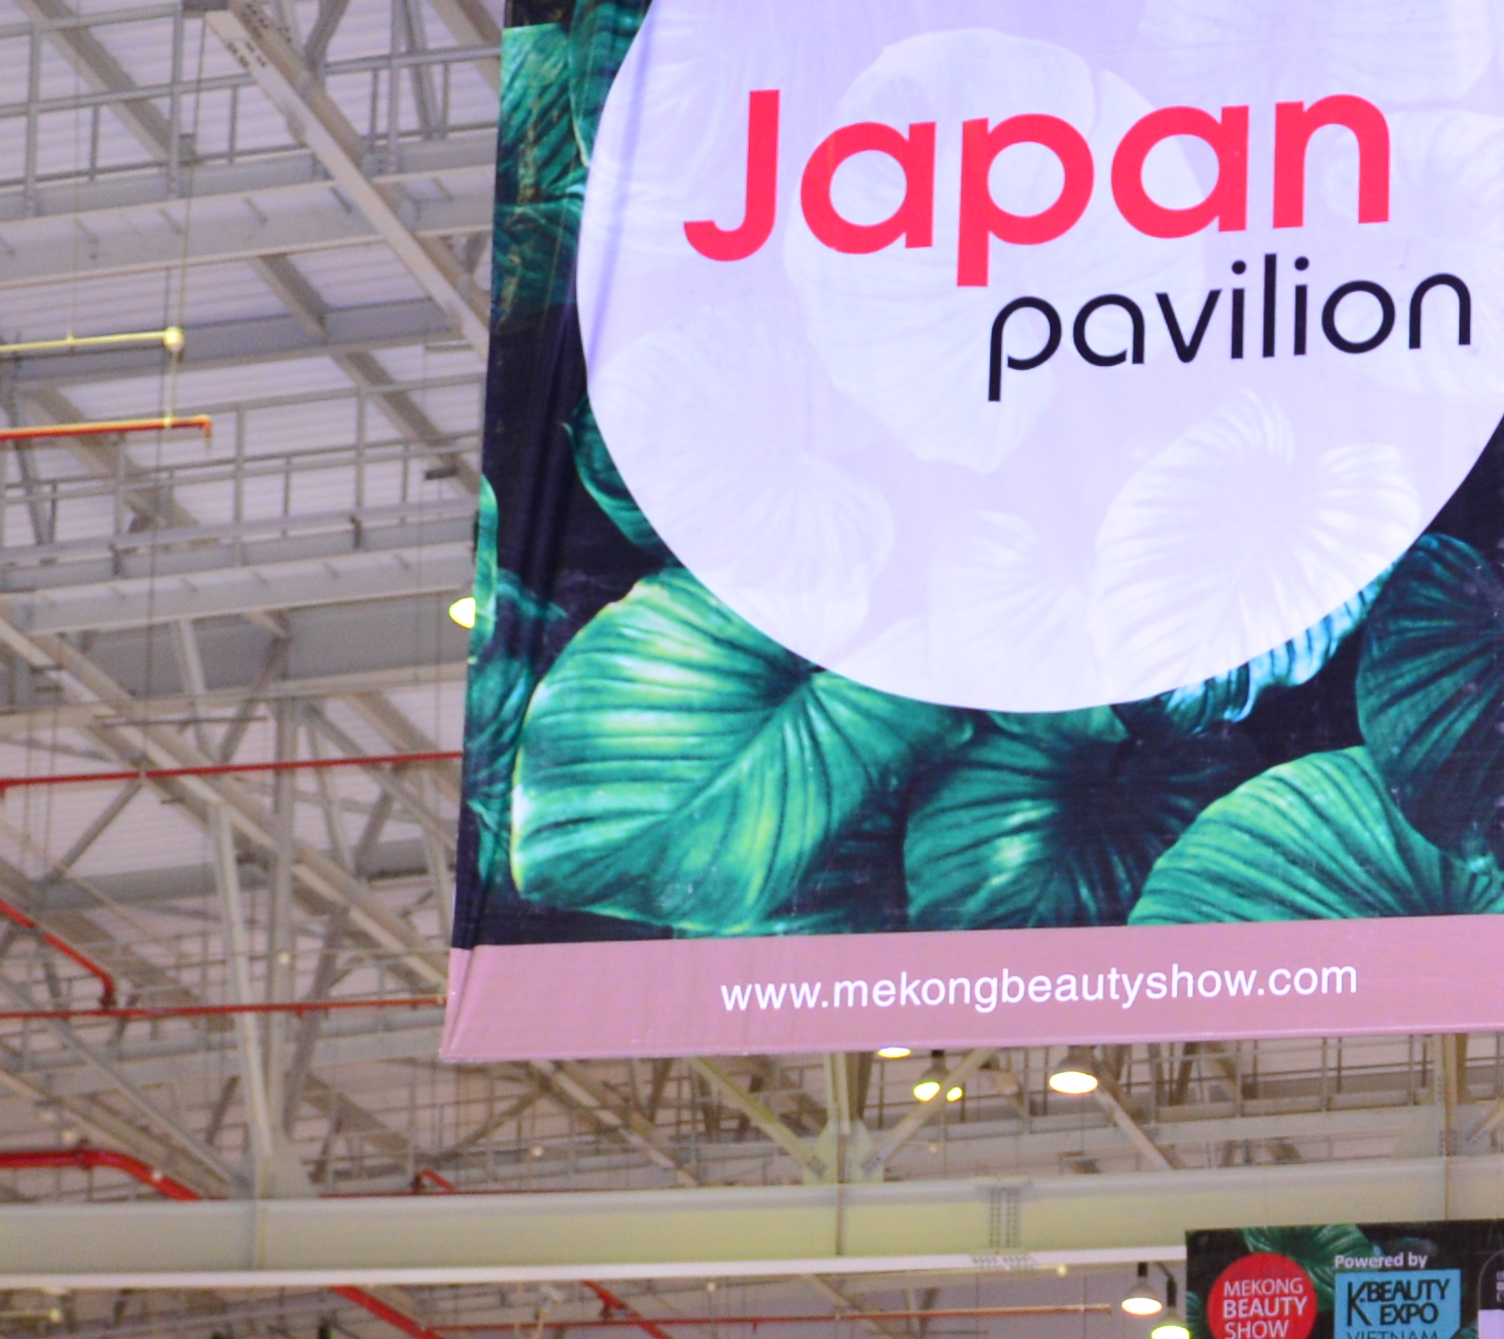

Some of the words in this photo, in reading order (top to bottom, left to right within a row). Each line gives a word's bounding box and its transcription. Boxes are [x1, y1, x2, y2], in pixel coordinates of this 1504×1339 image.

[683, 90, 1391, 287] Japan
[988, 254, 1473, 403] pavilion
[719, 959, 1359, 1016] www.mekongbeautyshow.com
[1334, 1253, 1404, 1269] Powered
[1408, 1252, 1428, 1269] by
[1223, 1278, 1303, 1297] MEKONG
[1222, 1296, 1308, 1320] BEAUTY
[1380, 1303, 1439, 1325] EXPO
